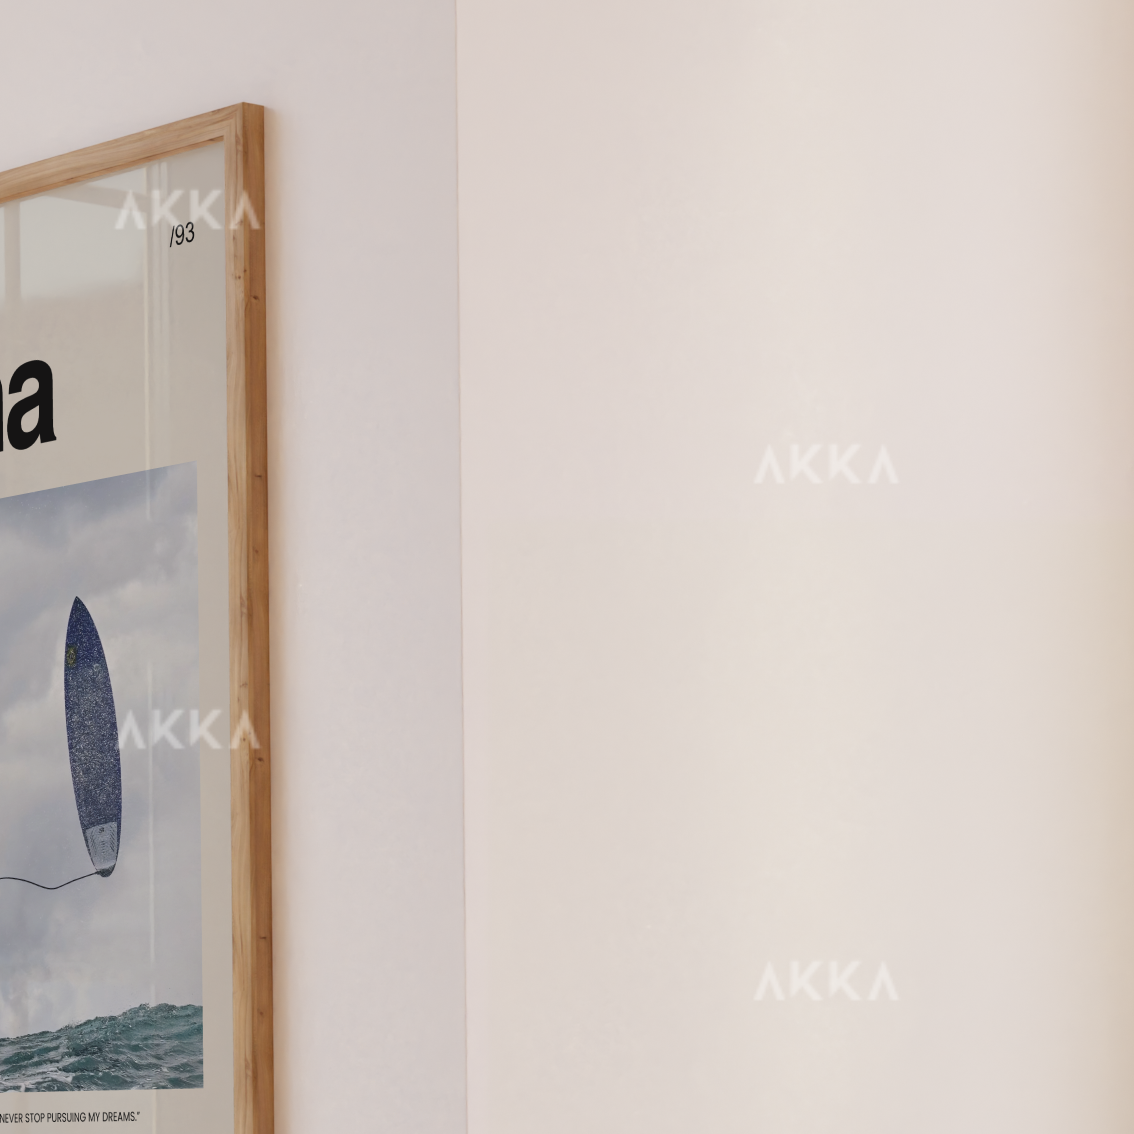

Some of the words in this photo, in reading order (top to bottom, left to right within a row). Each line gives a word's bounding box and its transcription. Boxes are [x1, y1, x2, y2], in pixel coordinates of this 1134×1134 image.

[170, 222, 195, 248] /93
[24, 1112, 45, 1123] STOP
[46, 1112, 86, 1122] PURSUING
[87, 1112, 100, 1122] MY
